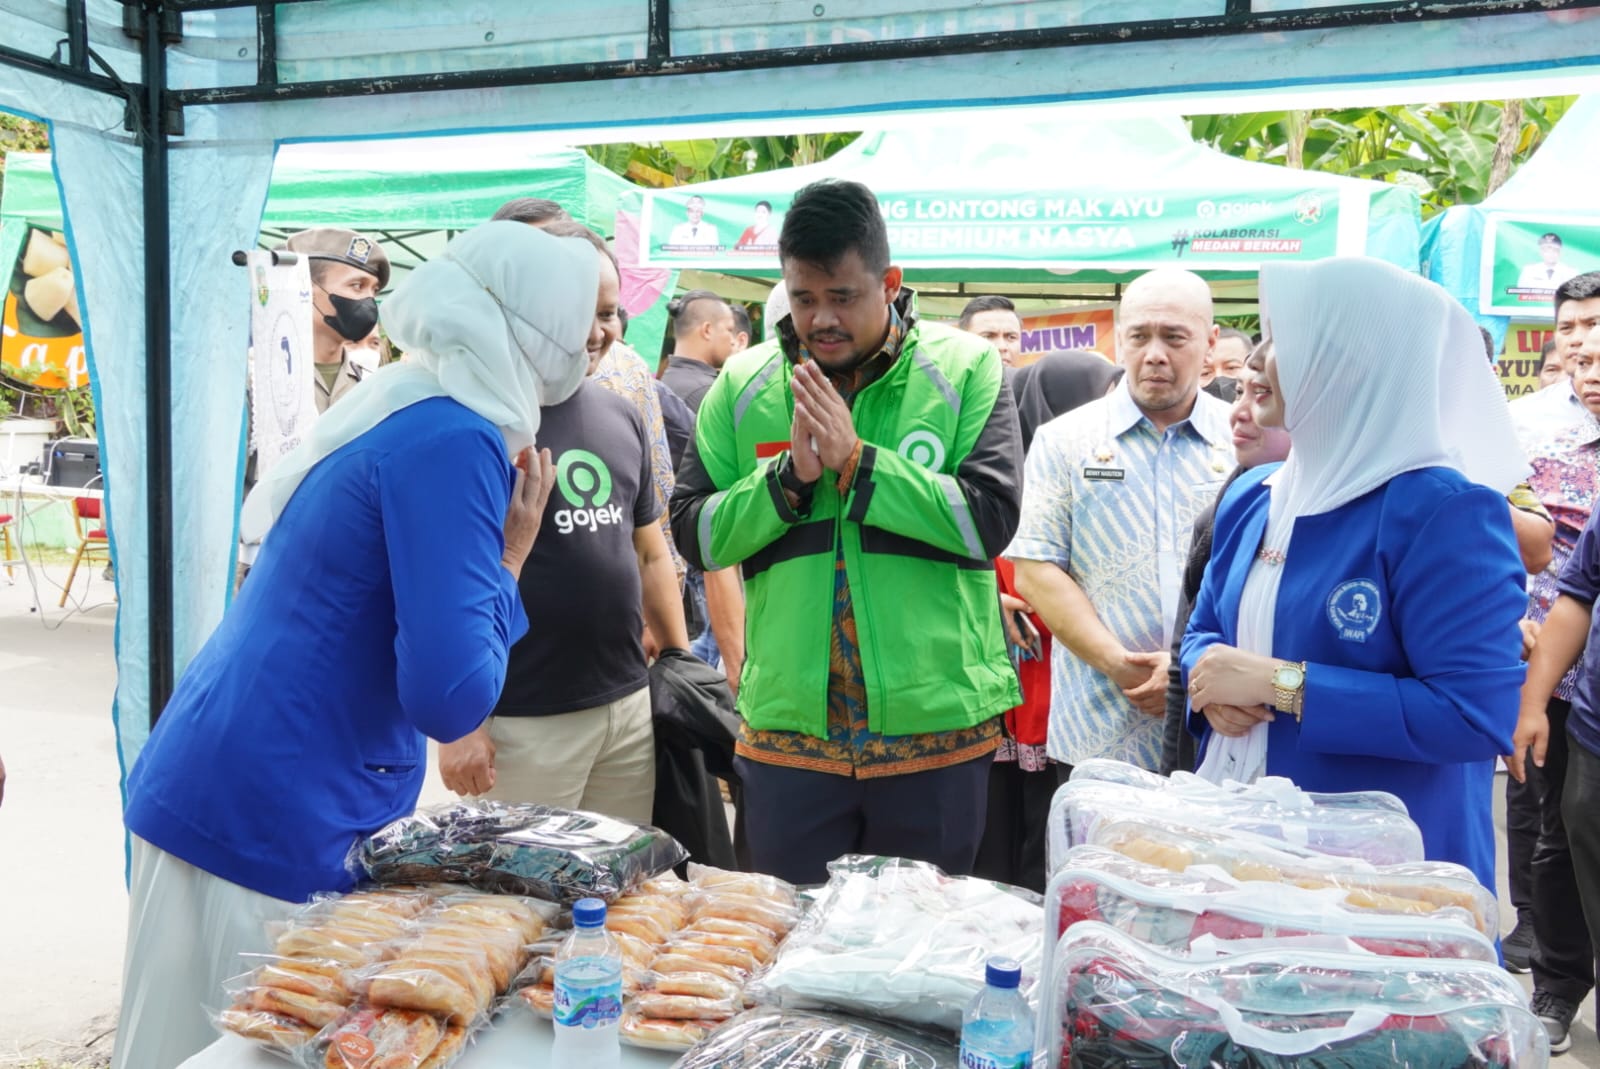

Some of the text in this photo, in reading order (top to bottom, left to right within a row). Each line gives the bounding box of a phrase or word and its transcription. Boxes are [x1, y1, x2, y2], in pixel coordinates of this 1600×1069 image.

[915, 200, 1037, 219] LONTONG
[1045, 199, 1103, 218] MAK
[1109, 197, 1165, 218] AYU
[1218, 199, 1274, 219] gojek
[886, 226, 1136, 249] PREMIUM NASYA
[1191, 240, 1301, 252] MEDAN BERKAH
[1020, 324, 1095, 354] MIUM
[554, 504, 623, 534] gojek
